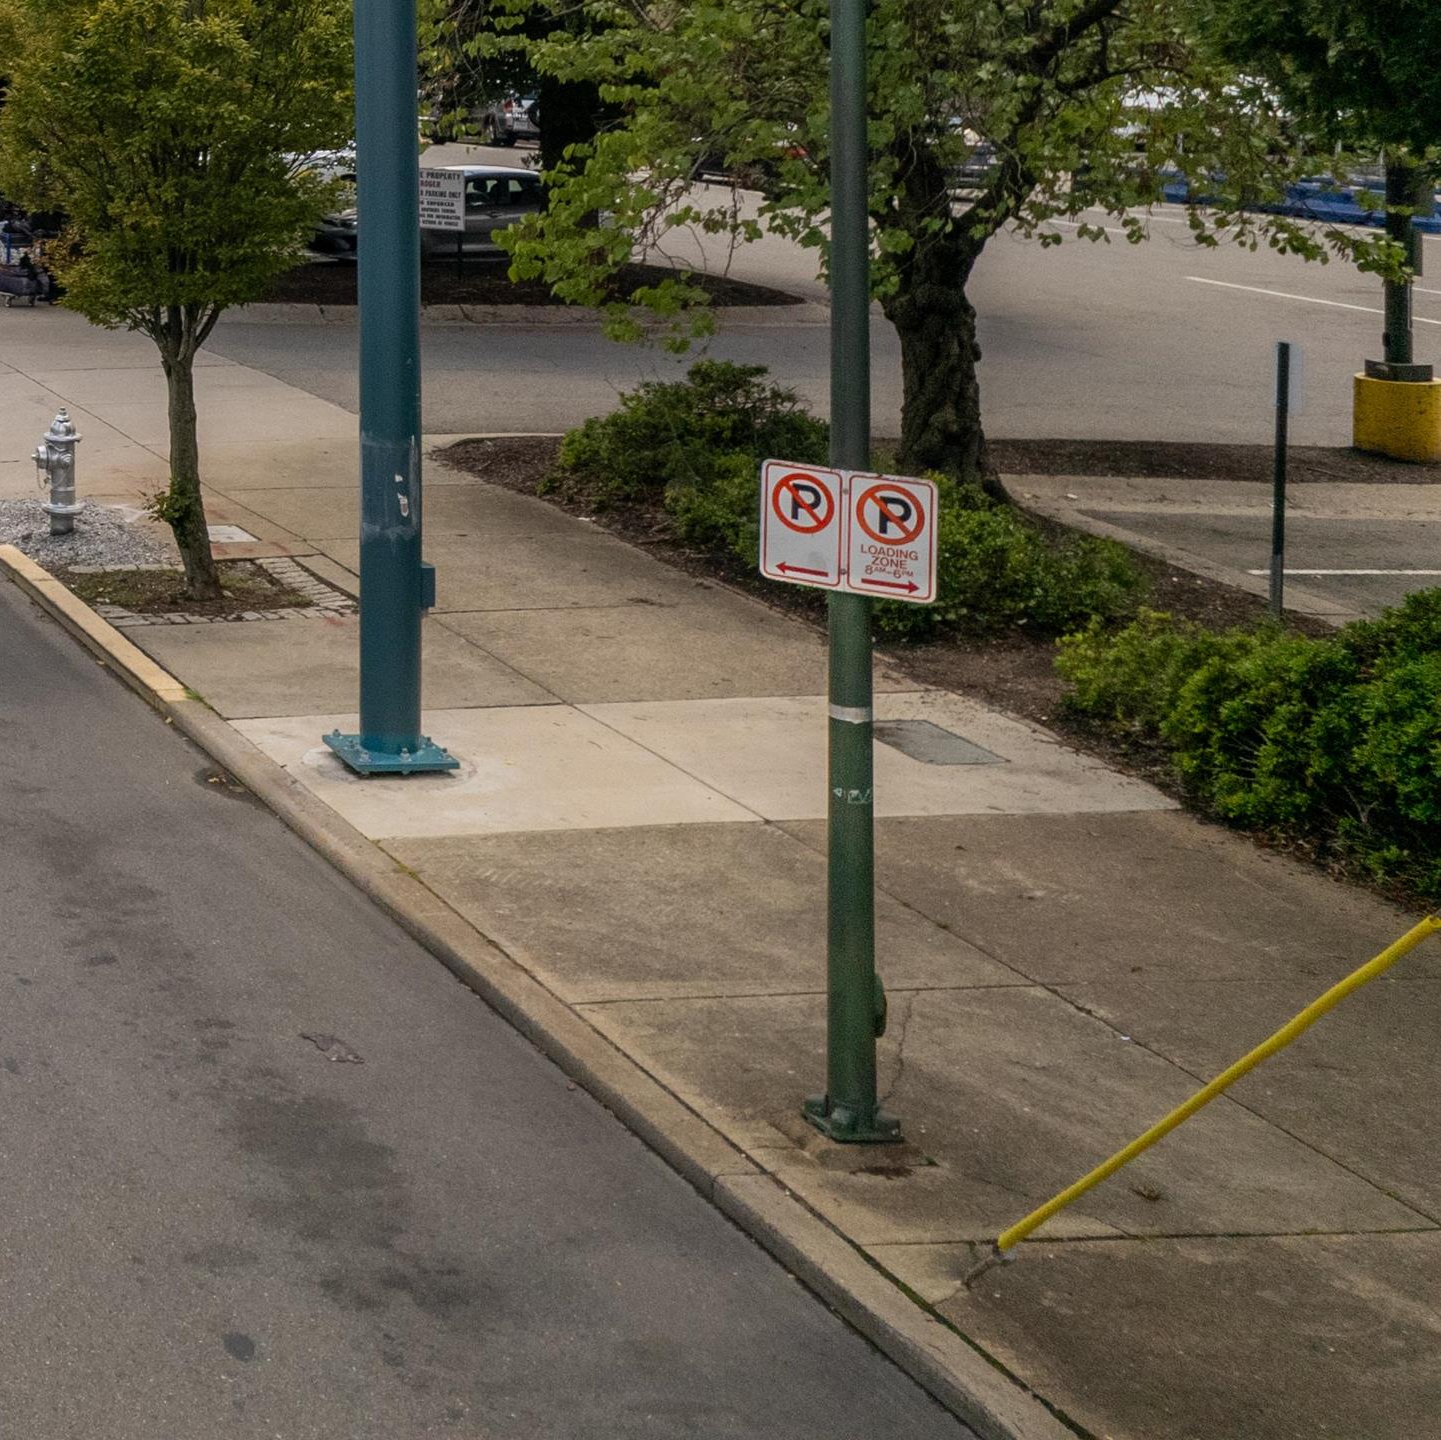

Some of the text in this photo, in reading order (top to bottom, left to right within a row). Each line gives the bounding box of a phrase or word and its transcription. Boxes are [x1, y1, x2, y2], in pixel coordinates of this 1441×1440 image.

[420, 180, 440, 188] ROGER
[861, 544, 919, 561] LOADING
[871, 555, 907, 569] ZONE
